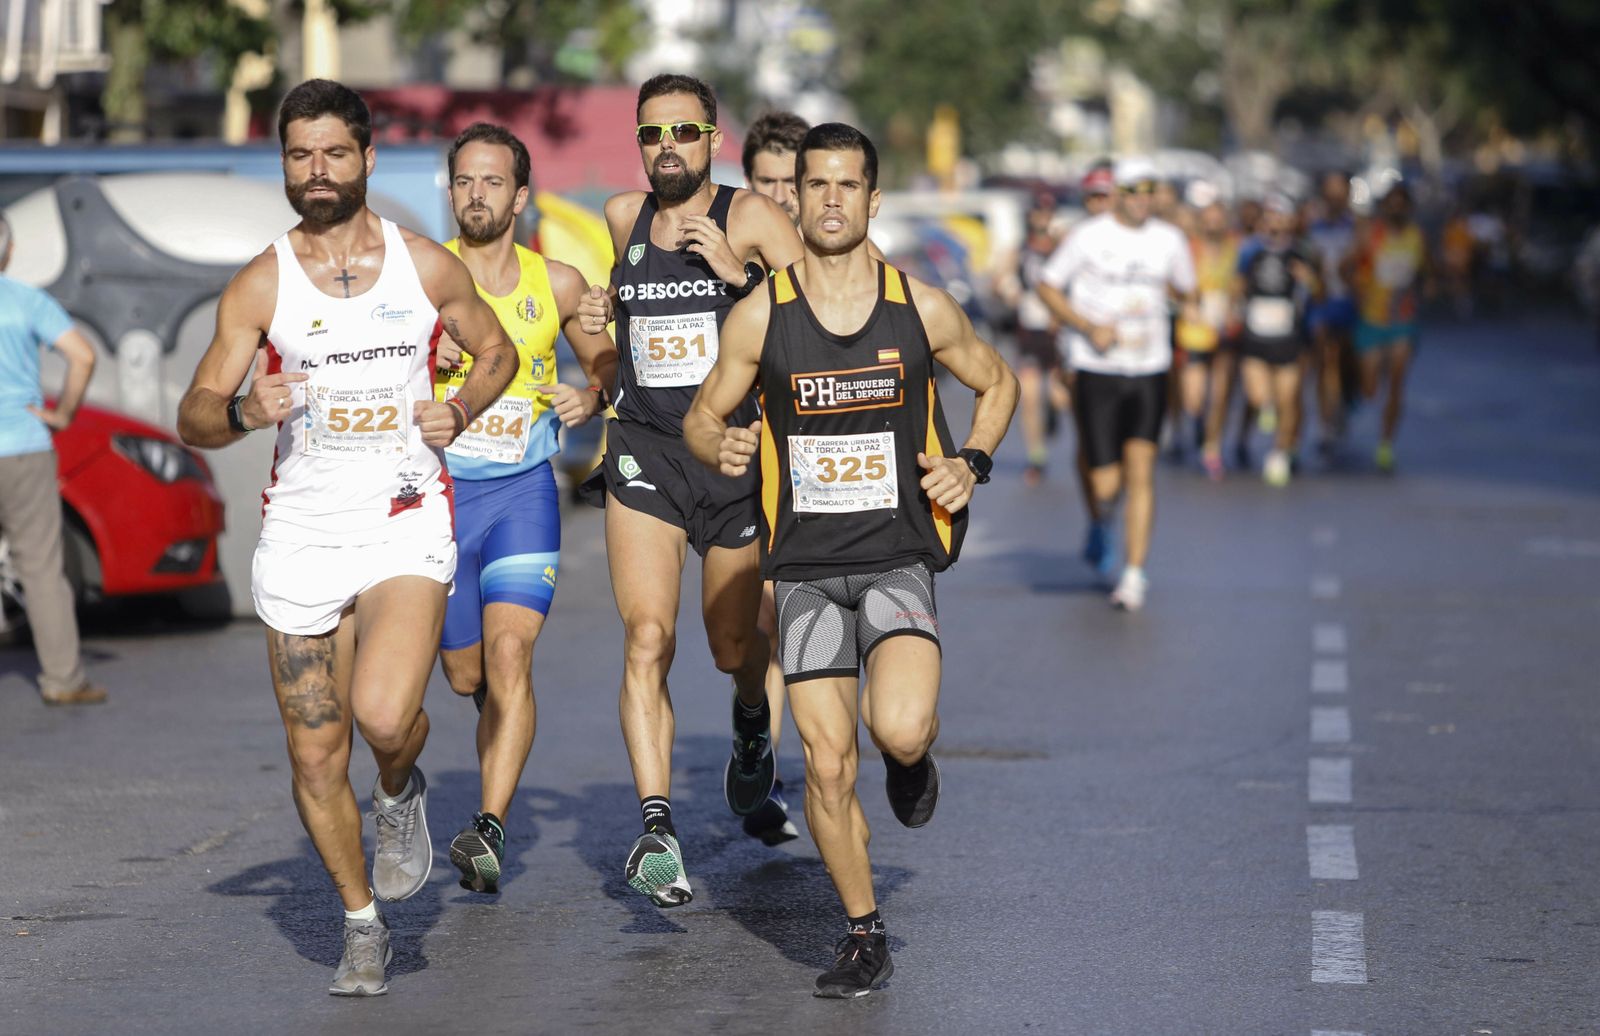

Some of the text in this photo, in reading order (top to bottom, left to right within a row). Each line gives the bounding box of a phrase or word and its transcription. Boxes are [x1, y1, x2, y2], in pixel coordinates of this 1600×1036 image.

[619, 279, 727, 301] CD BESOCCER
[648, 333, 706, 361] 531
[366, 386, 393, 394] URBANA
[797, 377, 895, 407] PH PELUQUEROS
[836, 388, 895, 400] DEL DEPORTE
[327, 405, 398, 433] 522
[322, 443, 366, 452] DISMOAUTO
[454, 442, 493, 454] DISMOAUTO
[816, 454, 887, 483] 325
